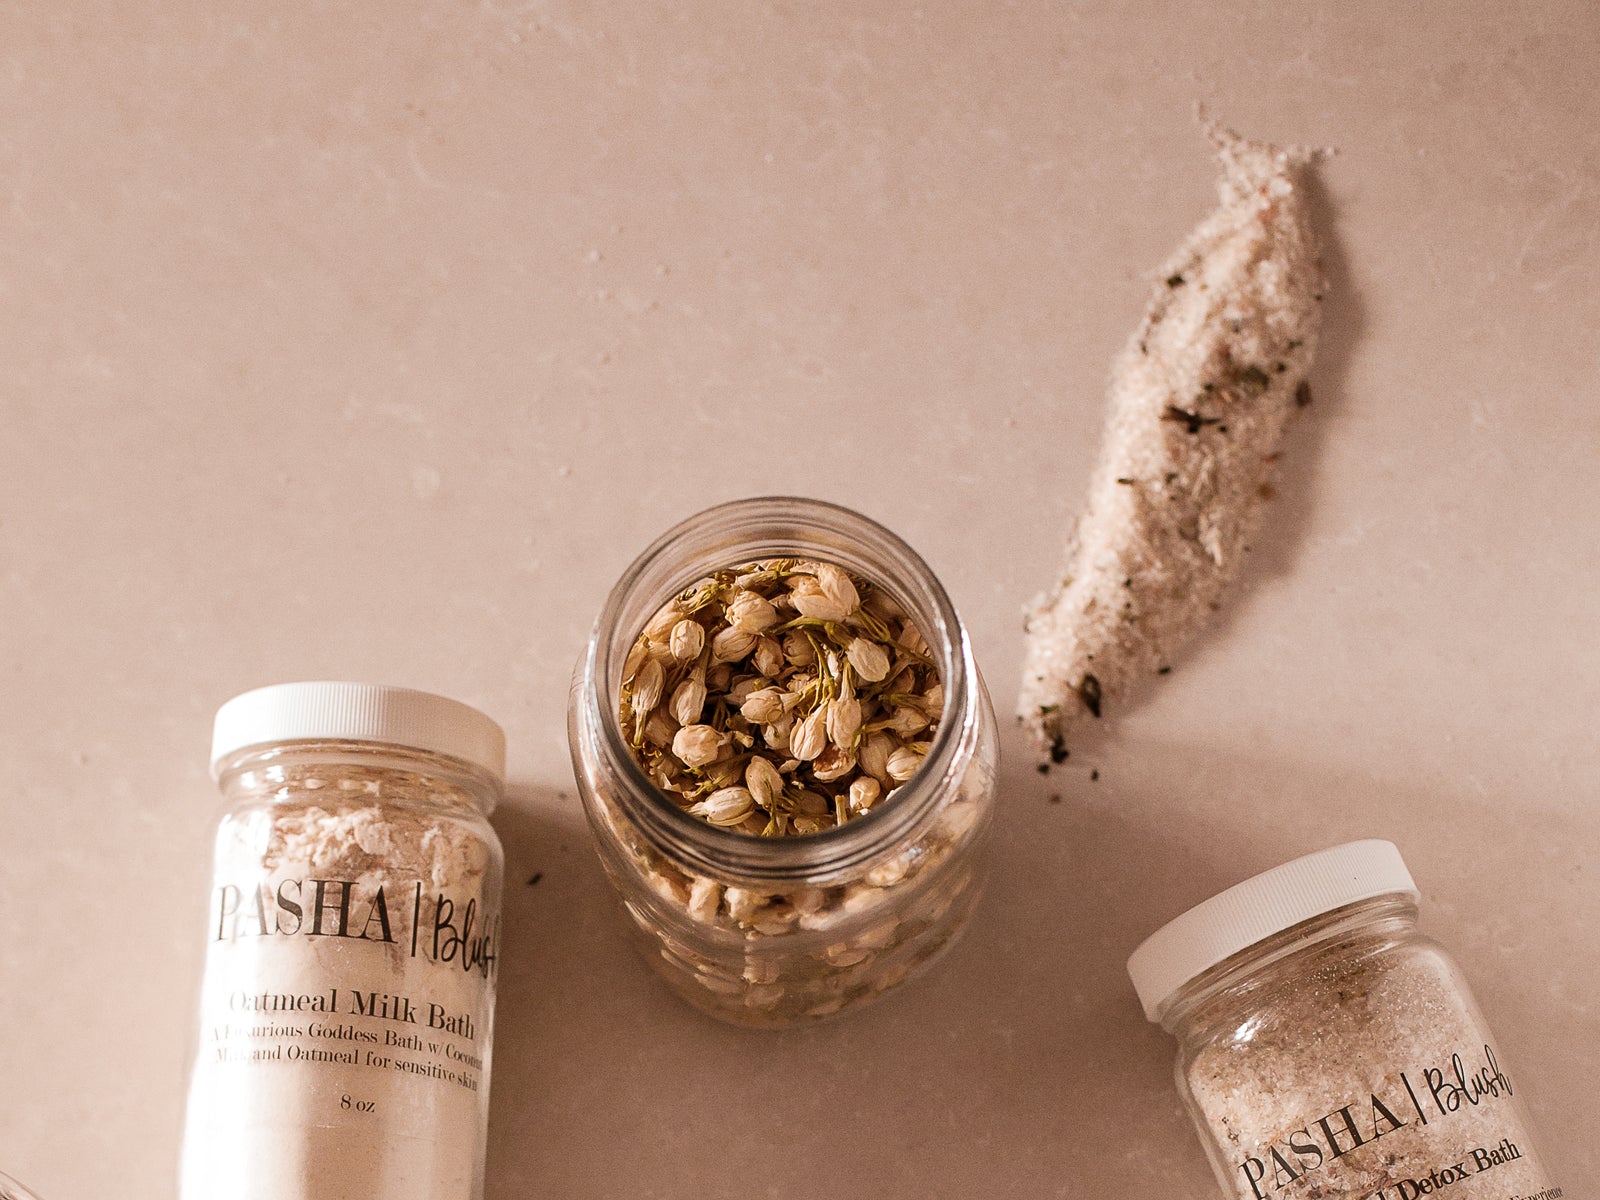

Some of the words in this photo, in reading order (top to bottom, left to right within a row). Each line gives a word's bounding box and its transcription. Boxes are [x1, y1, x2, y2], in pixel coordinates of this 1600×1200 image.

[214, 878, 398, 944] PASHA
[229, 988, 338, 1014] Oatmeal
[348, 989, 417, 1024] Milk
[425, 1002, 476, 1041] Bath
[308, 1022, 379, 1044] Goddess
[385, 1029, 423, 1052] Bath
[427, 1042, 444, 1057] w/
[252, 1045, 281, 1061] and
[287, 1044, 359, 1065] Oatmeal
[365, 1051, 391, 1069] for
[394, 1055, 455, 1082] sensitive
[457, 1070, 478, 1092] skin
[1423, 1044, 1514, 1116] Blush
[340, 1094, 351, 1110] 8
[356, 1099, 376, 1113] oz
[1467, 1138, 1523, 1174] Bath
